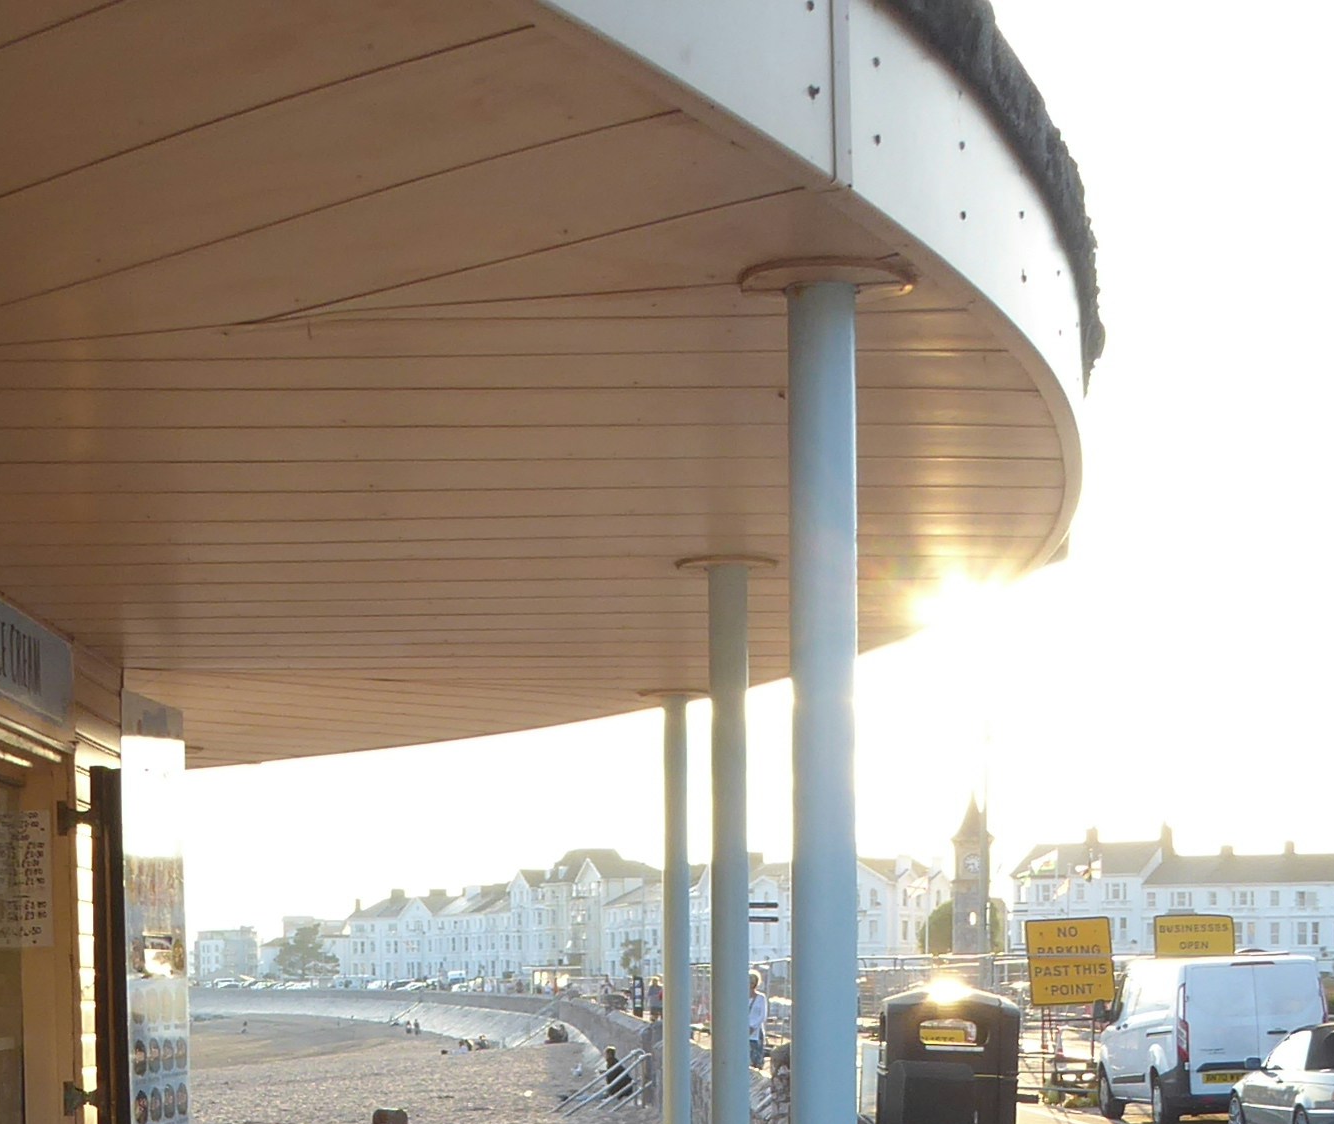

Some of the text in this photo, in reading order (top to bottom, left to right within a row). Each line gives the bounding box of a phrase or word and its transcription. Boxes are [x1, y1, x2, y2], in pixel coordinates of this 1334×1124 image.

[9, 623, 43, 697] CREAM
[1056, 926, 1078, 938] NO
[1158, 923, 1229, 934] BUSINESSES
[1036, 944, 1101, 958] PARKING
[1179, 940, 1210, 951] OPEN
[1034, 963, 1107, 977] PAST THIS
[1050, 983, 1094, 996] POINT
